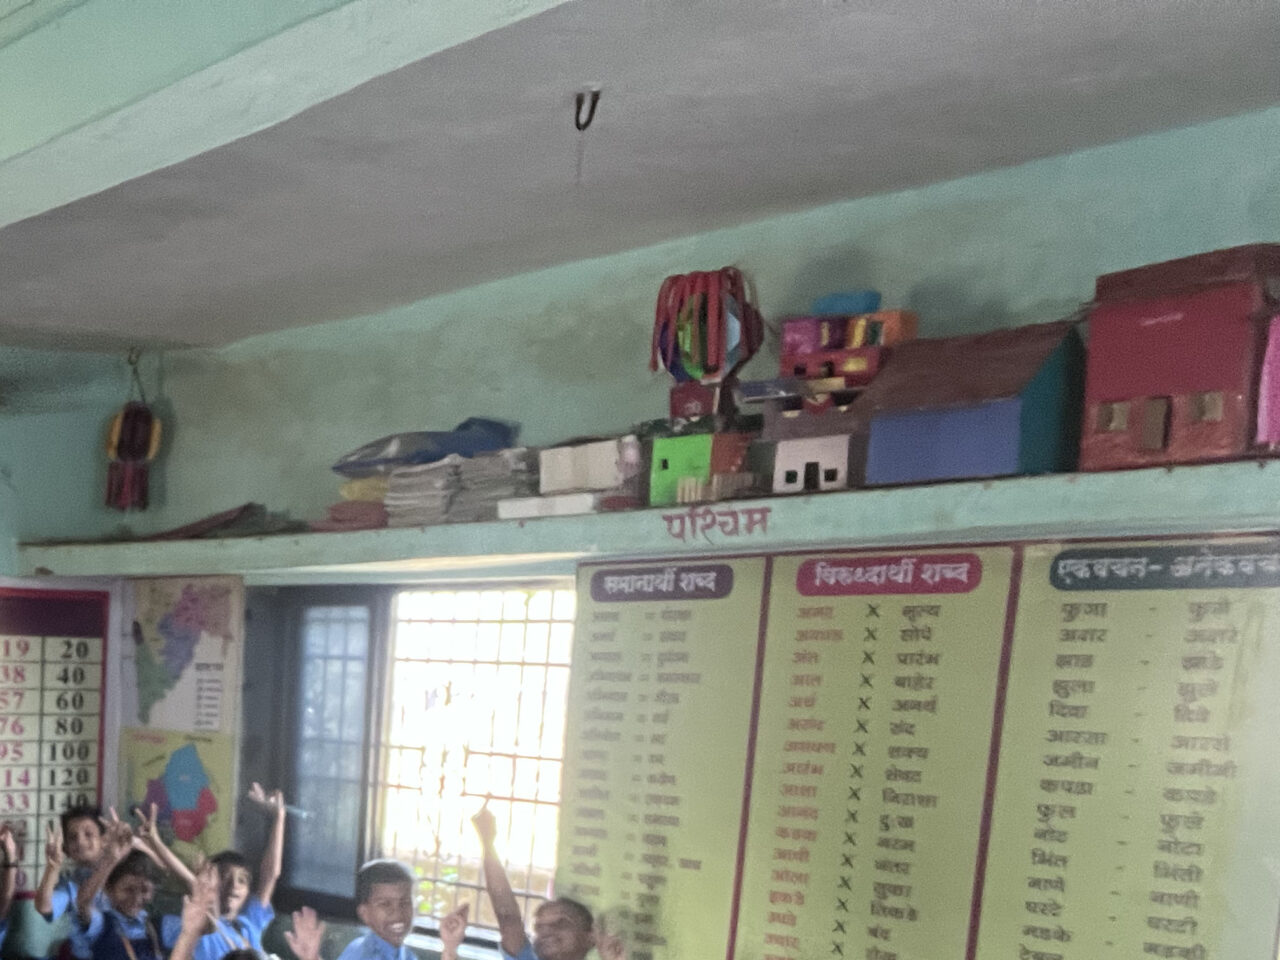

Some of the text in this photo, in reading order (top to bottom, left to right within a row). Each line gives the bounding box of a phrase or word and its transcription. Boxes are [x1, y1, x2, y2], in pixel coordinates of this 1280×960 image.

[662, 504, 772, 545] पश्चिम
[1, 639, 29, 656] 19
[62, 640, 89, 659] 20
[58, 666, 86, 685] 40
[0, 691, 24, 709] 57
[56, 693, 84, 711] 60
[56, 719, 83, 736] 80
[51, 743, 89, 762] 100
[50, 767, 89, 785] 120
